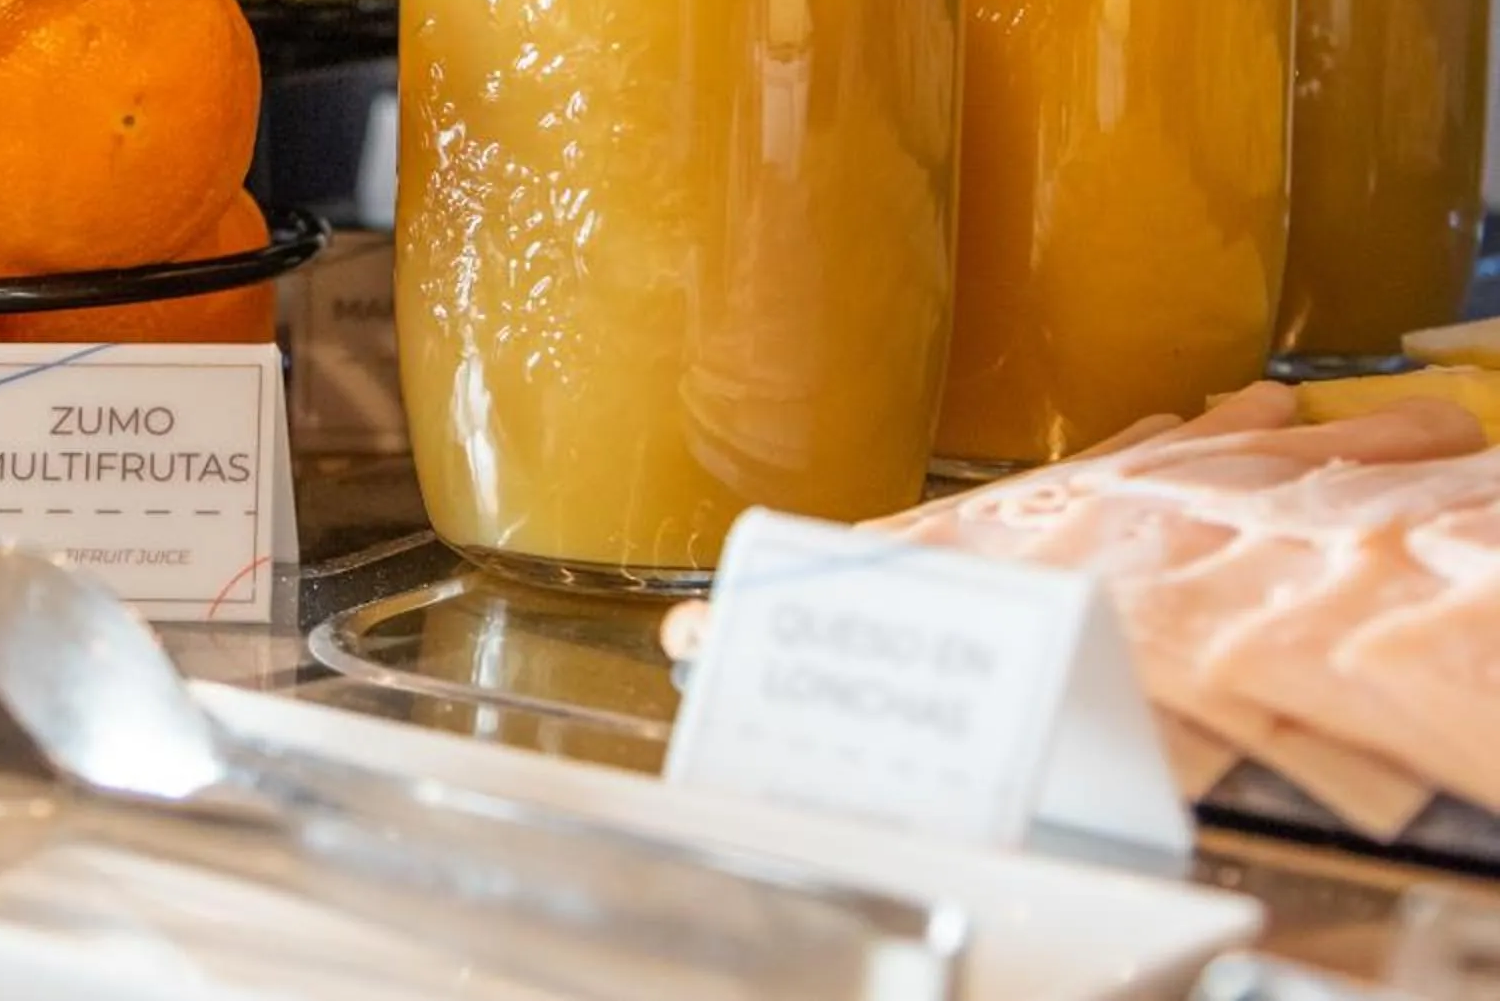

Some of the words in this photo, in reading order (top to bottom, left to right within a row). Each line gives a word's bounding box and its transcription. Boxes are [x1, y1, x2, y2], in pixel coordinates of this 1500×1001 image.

[49, 405, 175, 436] ZUMO
[66, 547, 135, 565] TIFRUIT
[137, 548, 192, 566] JUICE
